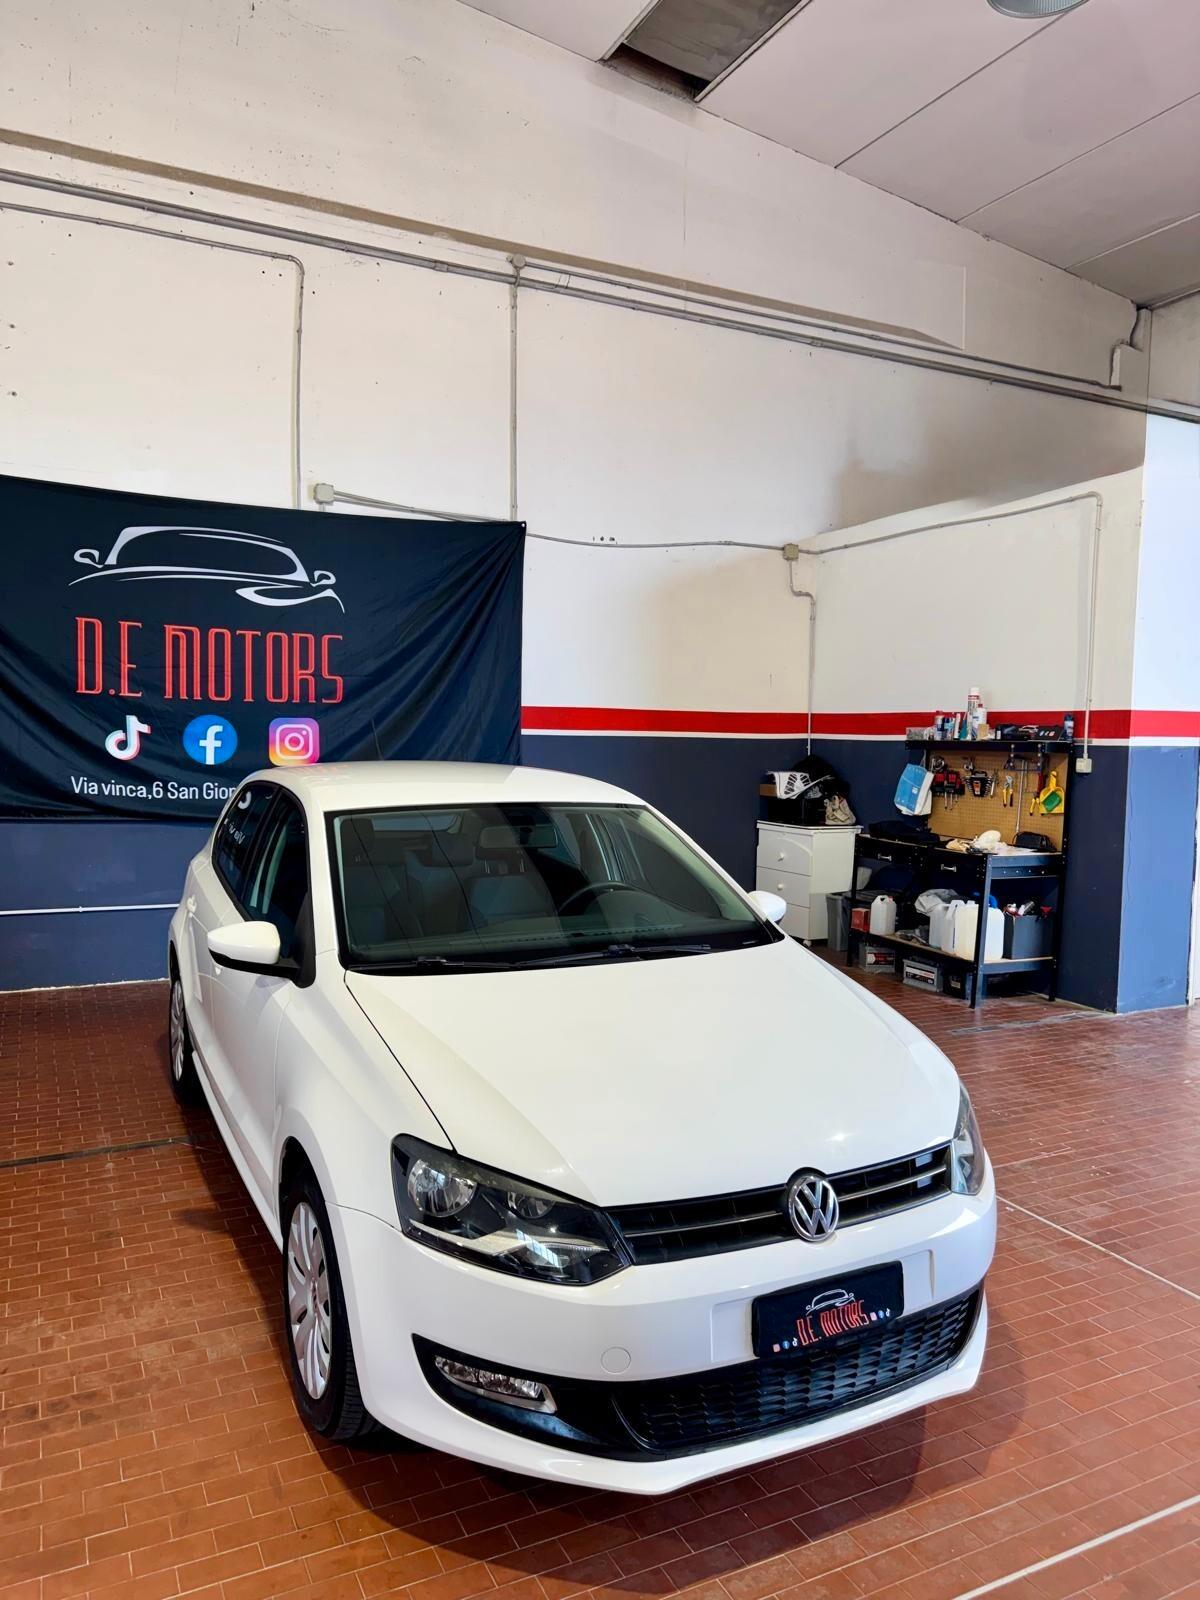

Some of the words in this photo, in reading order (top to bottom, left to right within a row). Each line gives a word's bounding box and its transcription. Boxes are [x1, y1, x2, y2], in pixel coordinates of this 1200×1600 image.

[75, 616, 142, 697] D.E
[163, 624, 343, 703] MOTORS
[71, 776, 98, 795] Via
[101, 780, 163, 800] vinca,6
[167, 781, 199, 800] San
[820, 1300, 870, 1337] MOTORS
